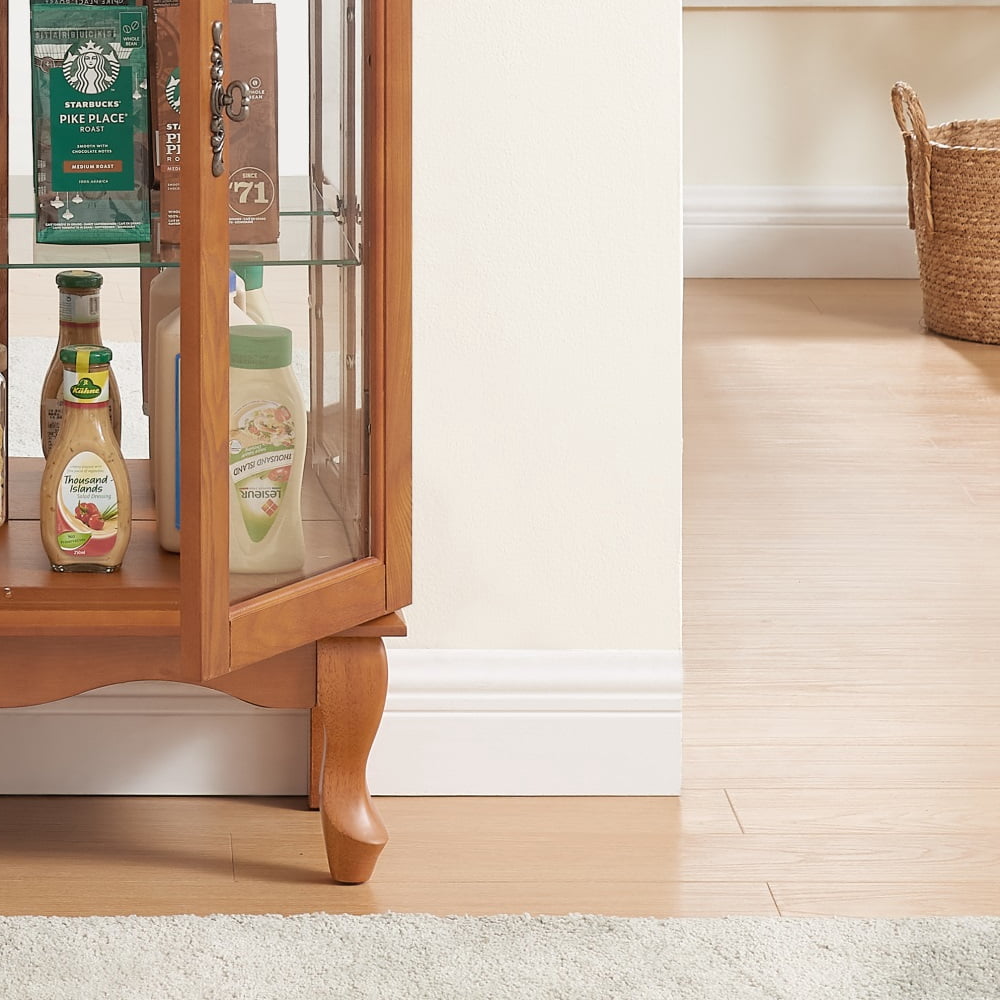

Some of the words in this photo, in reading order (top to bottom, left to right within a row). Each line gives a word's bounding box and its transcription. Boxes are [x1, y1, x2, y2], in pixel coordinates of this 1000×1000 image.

[59, 114, 85, 124] PIKE
[88, 113, 125, 123] PLACE
[256, 453, 292, 466] THOUSAND
[233, 462, 256, 476] ISLAND
[64, 475, 108, 484] Thousand
[70, 484, 103, 493] Islands
